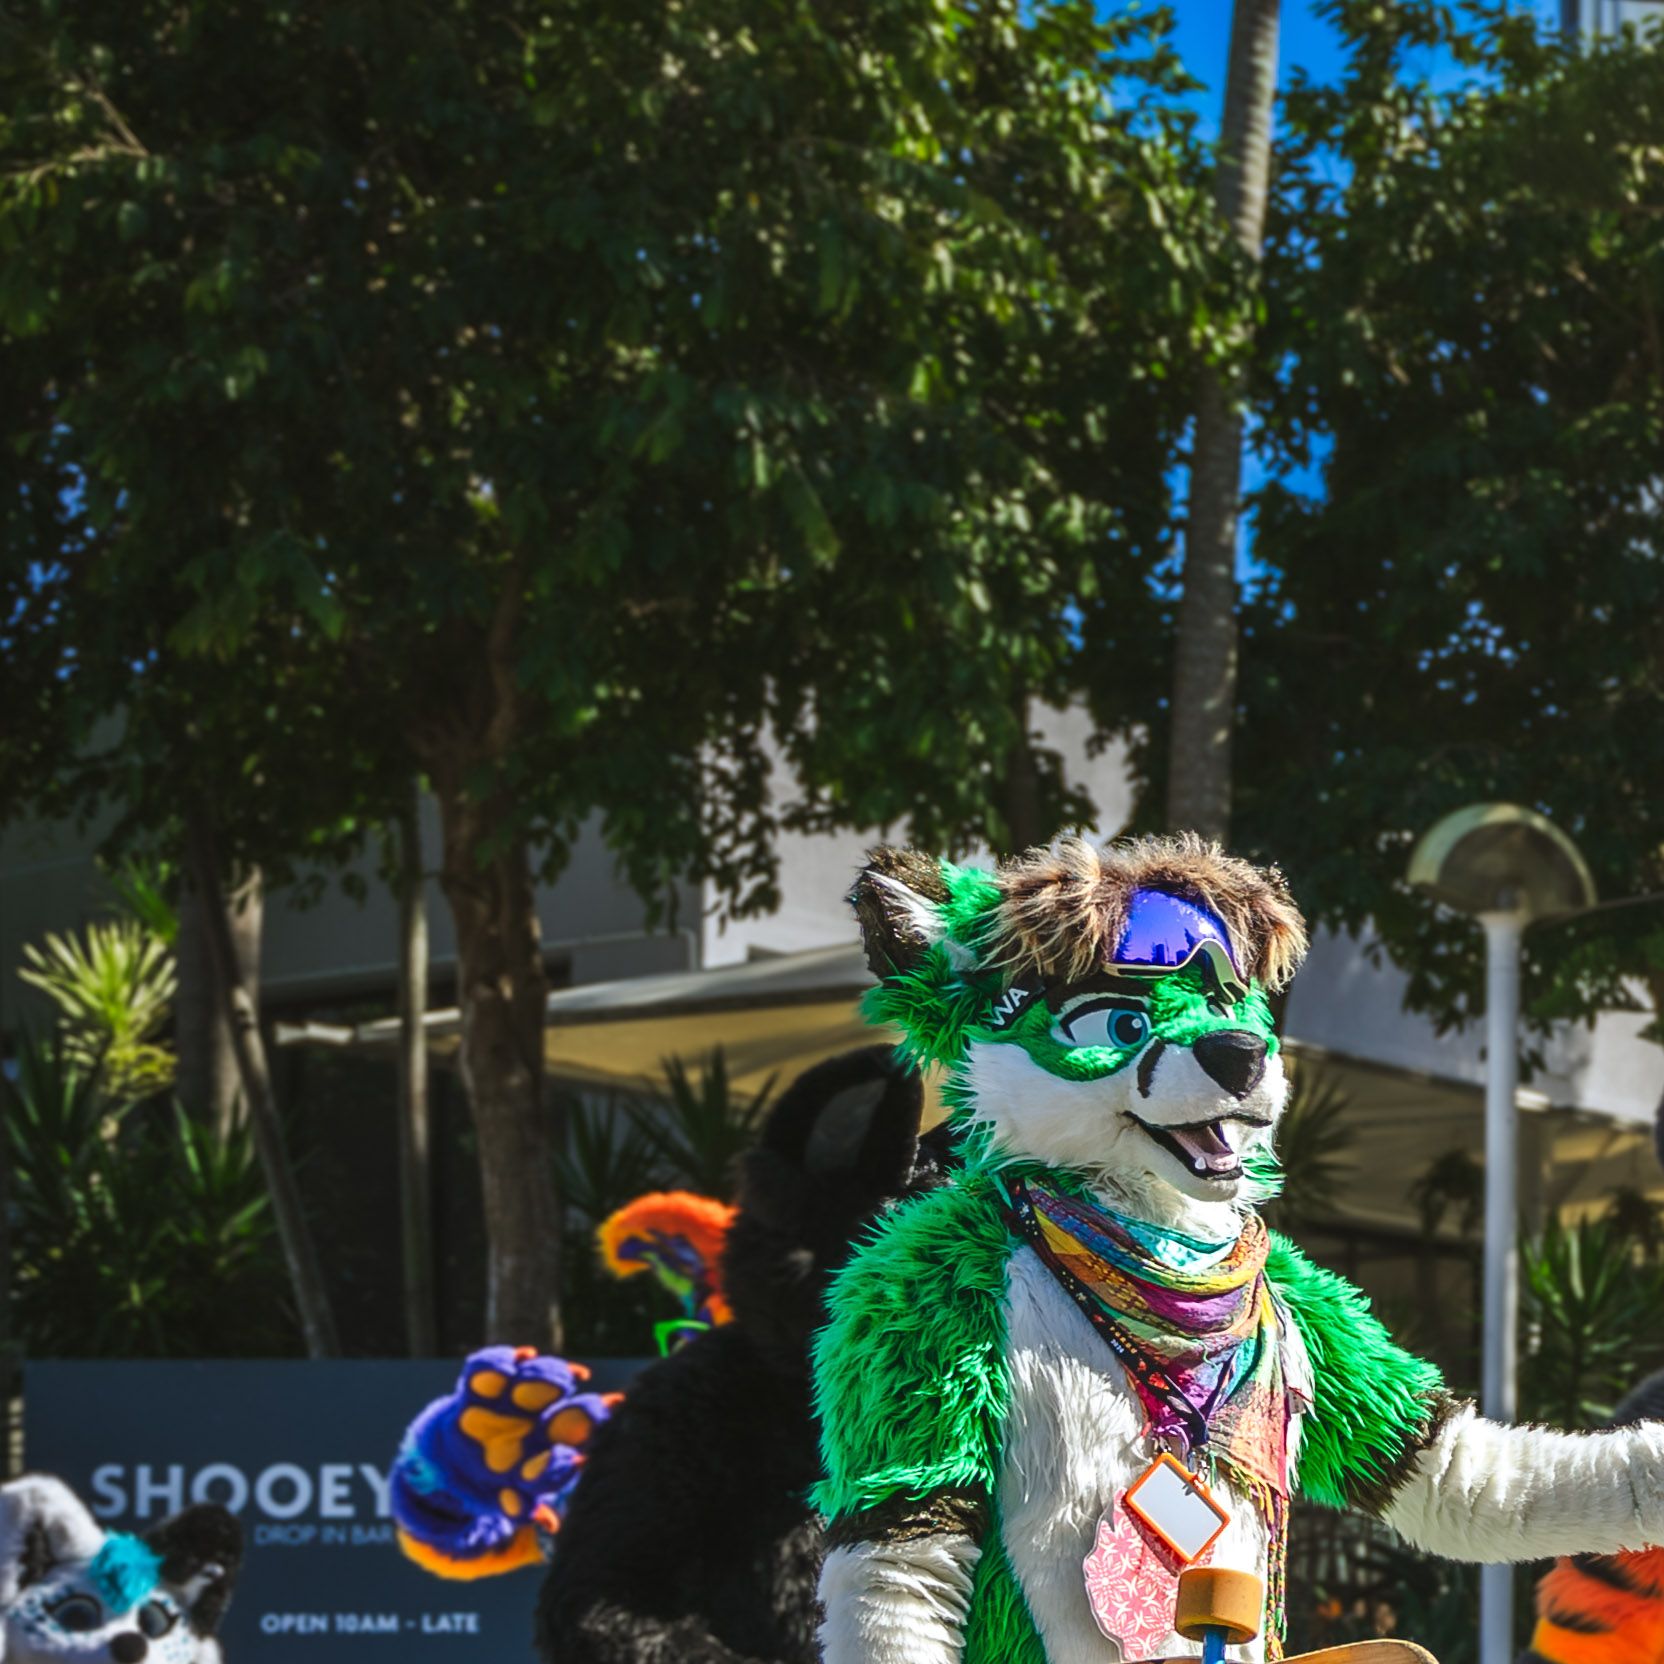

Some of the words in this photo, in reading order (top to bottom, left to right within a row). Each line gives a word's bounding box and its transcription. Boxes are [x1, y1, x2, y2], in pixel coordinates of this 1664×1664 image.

[255, 1525, 316, 1545] DROP
[321, 1525, 346, 1545] IN
[353, 1525, 395, 1545] BAR
[260, 1613, 328, 1634] OPEN
[335, 1613, 399, 1633] 10AM
[422, 1613, 480, 1633] LATE
